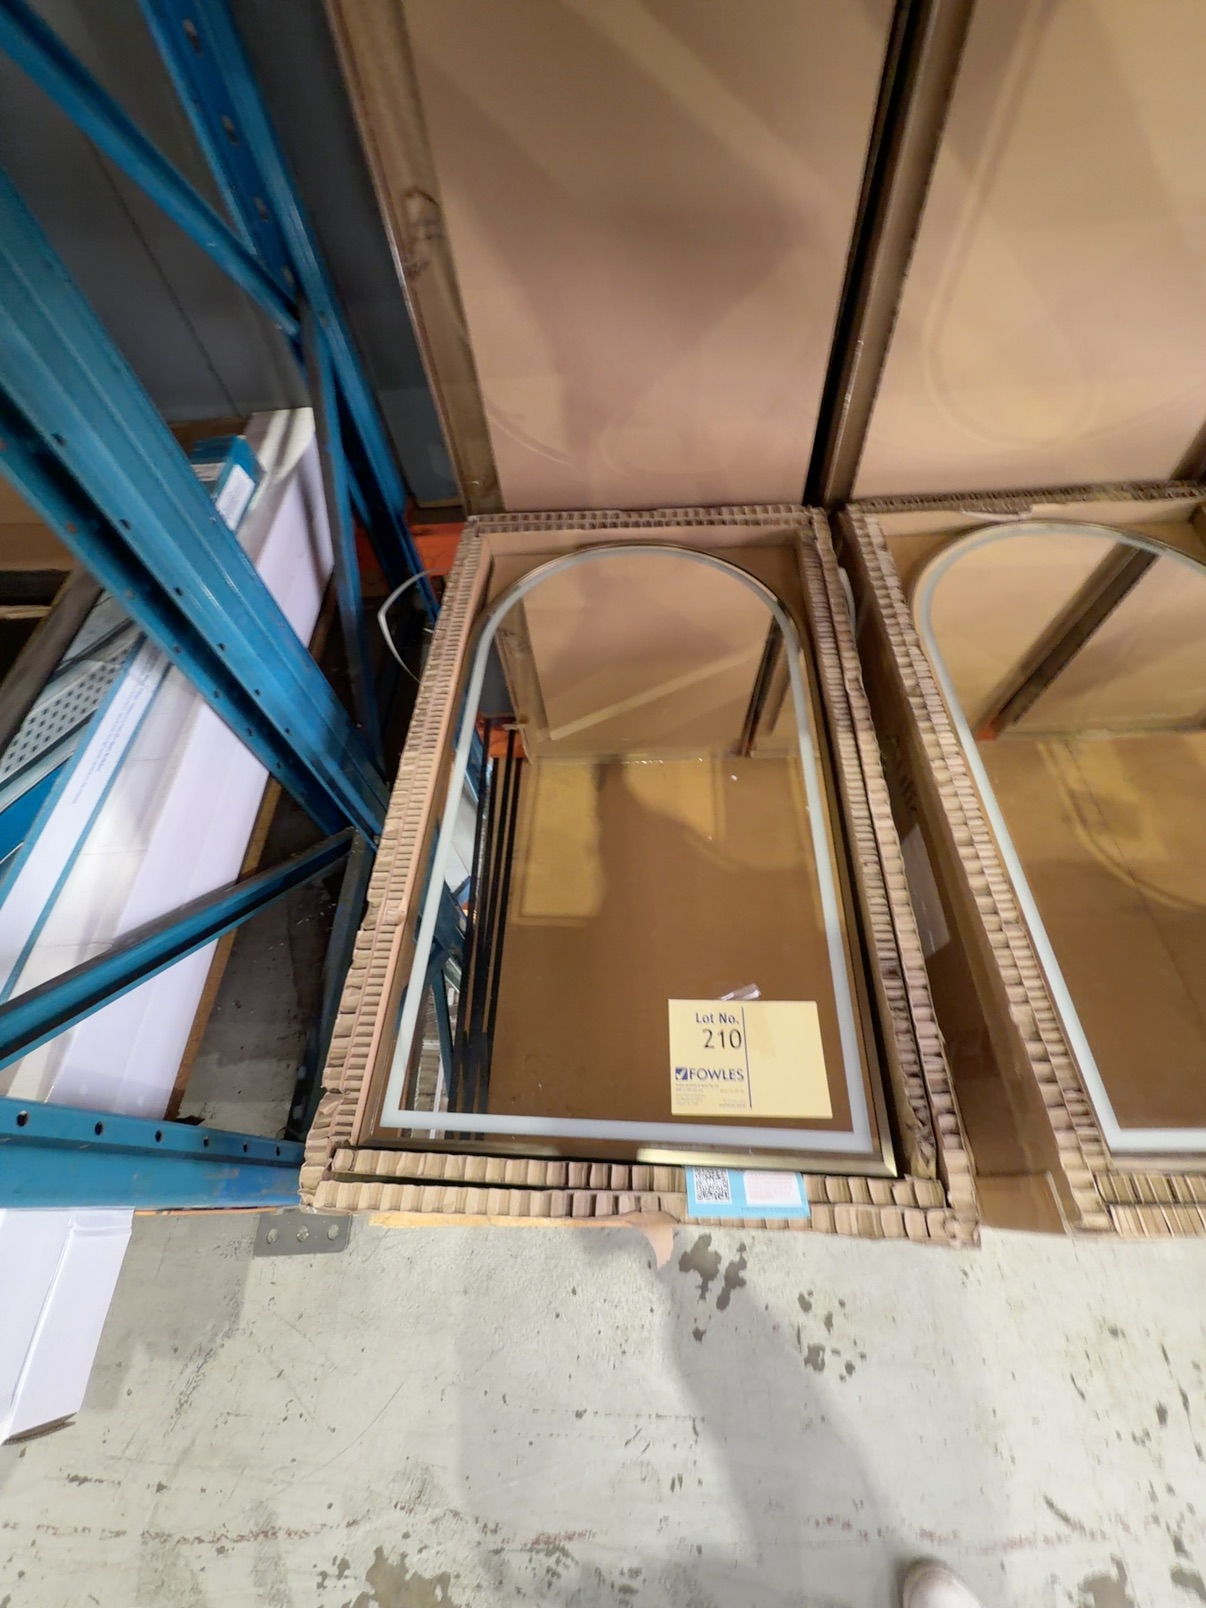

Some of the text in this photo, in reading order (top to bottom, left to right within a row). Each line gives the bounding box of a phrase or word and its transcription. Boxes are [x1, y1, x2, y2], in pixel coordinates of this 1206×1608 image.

[695, 1011, 740, 1025] Lot No.
[702, 1028, 742, 1050] 210
[689, 1067, 745, 1081] FOWLES
